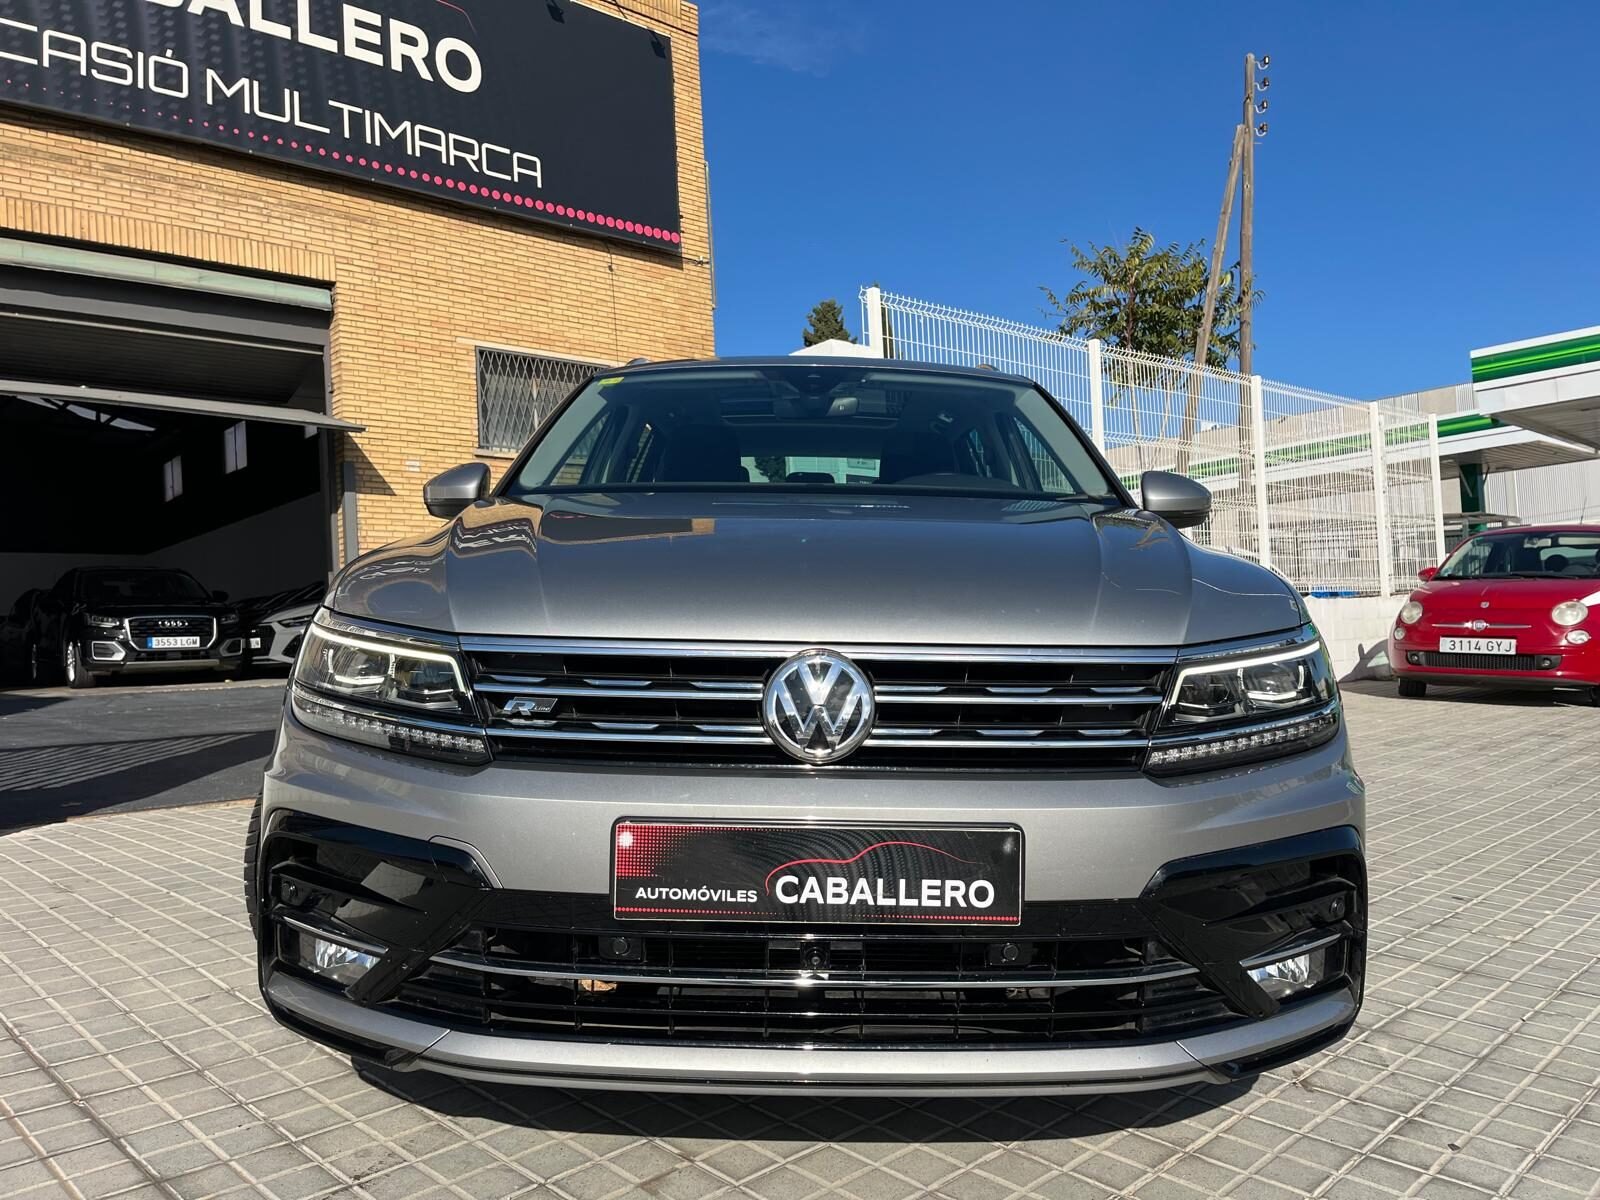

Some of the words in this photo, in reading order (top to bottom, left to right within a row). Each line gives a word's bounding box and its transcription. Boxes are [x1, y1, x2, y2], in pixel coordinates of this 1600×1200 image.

[206, 68, 542, 188] MULTIMARCA
[154, 638, 178, 647] 3553
[1449, 640, 1481, 651] 3114
[1486, 641, 1513, 652] GYJ
[635, 885, 758, 903] AUTOMÓVILES
[775, 875, 995, 909] CABALLERO
